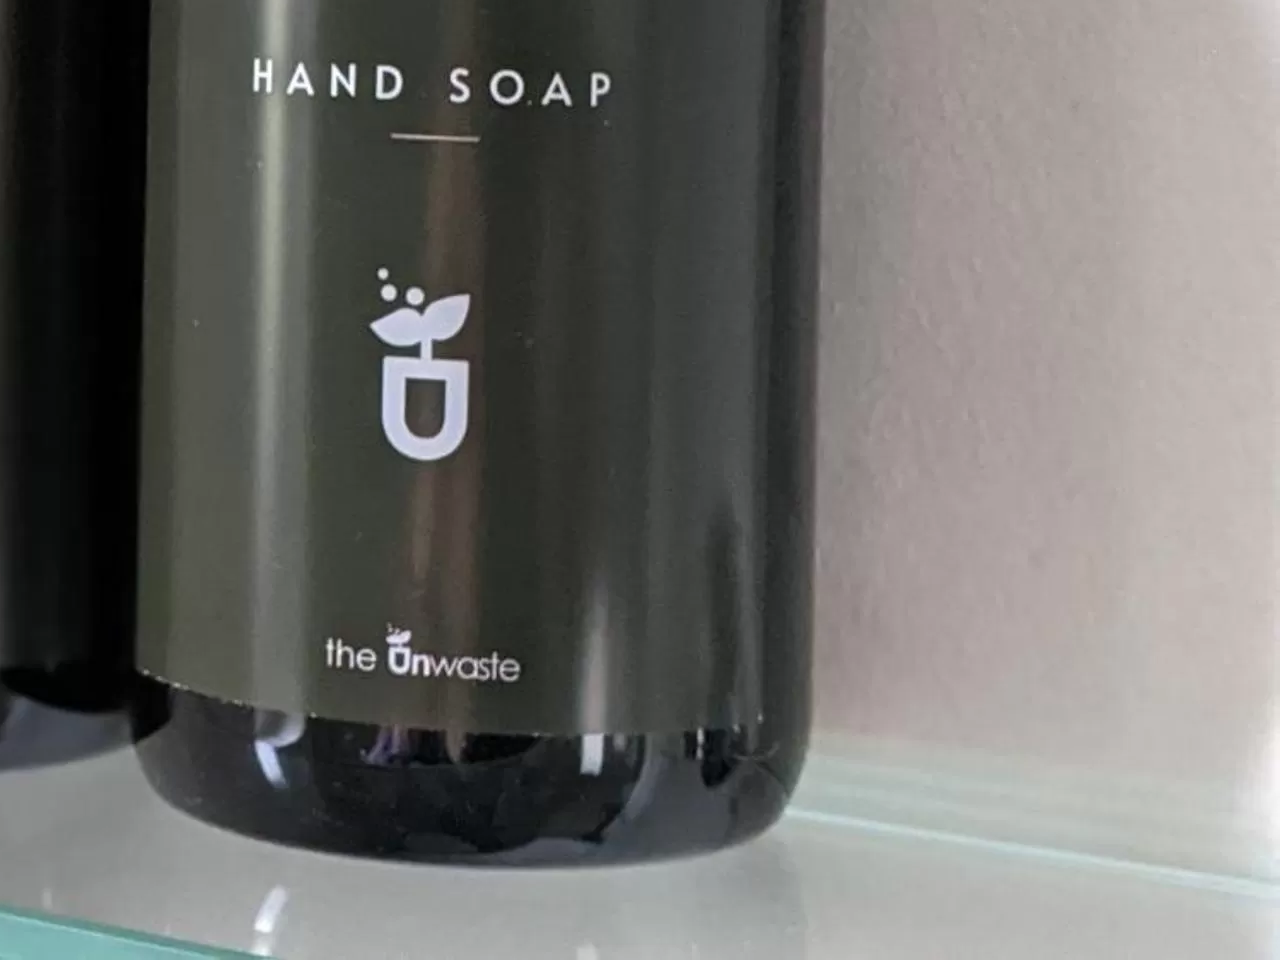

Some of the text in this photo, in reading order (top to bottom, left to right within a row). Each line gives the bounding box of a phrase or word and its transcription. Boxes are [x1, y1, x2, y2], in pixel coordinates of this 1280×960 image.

[252, 58, 611, 107] HAND SOAP
[325, 637, 376, 671] the
